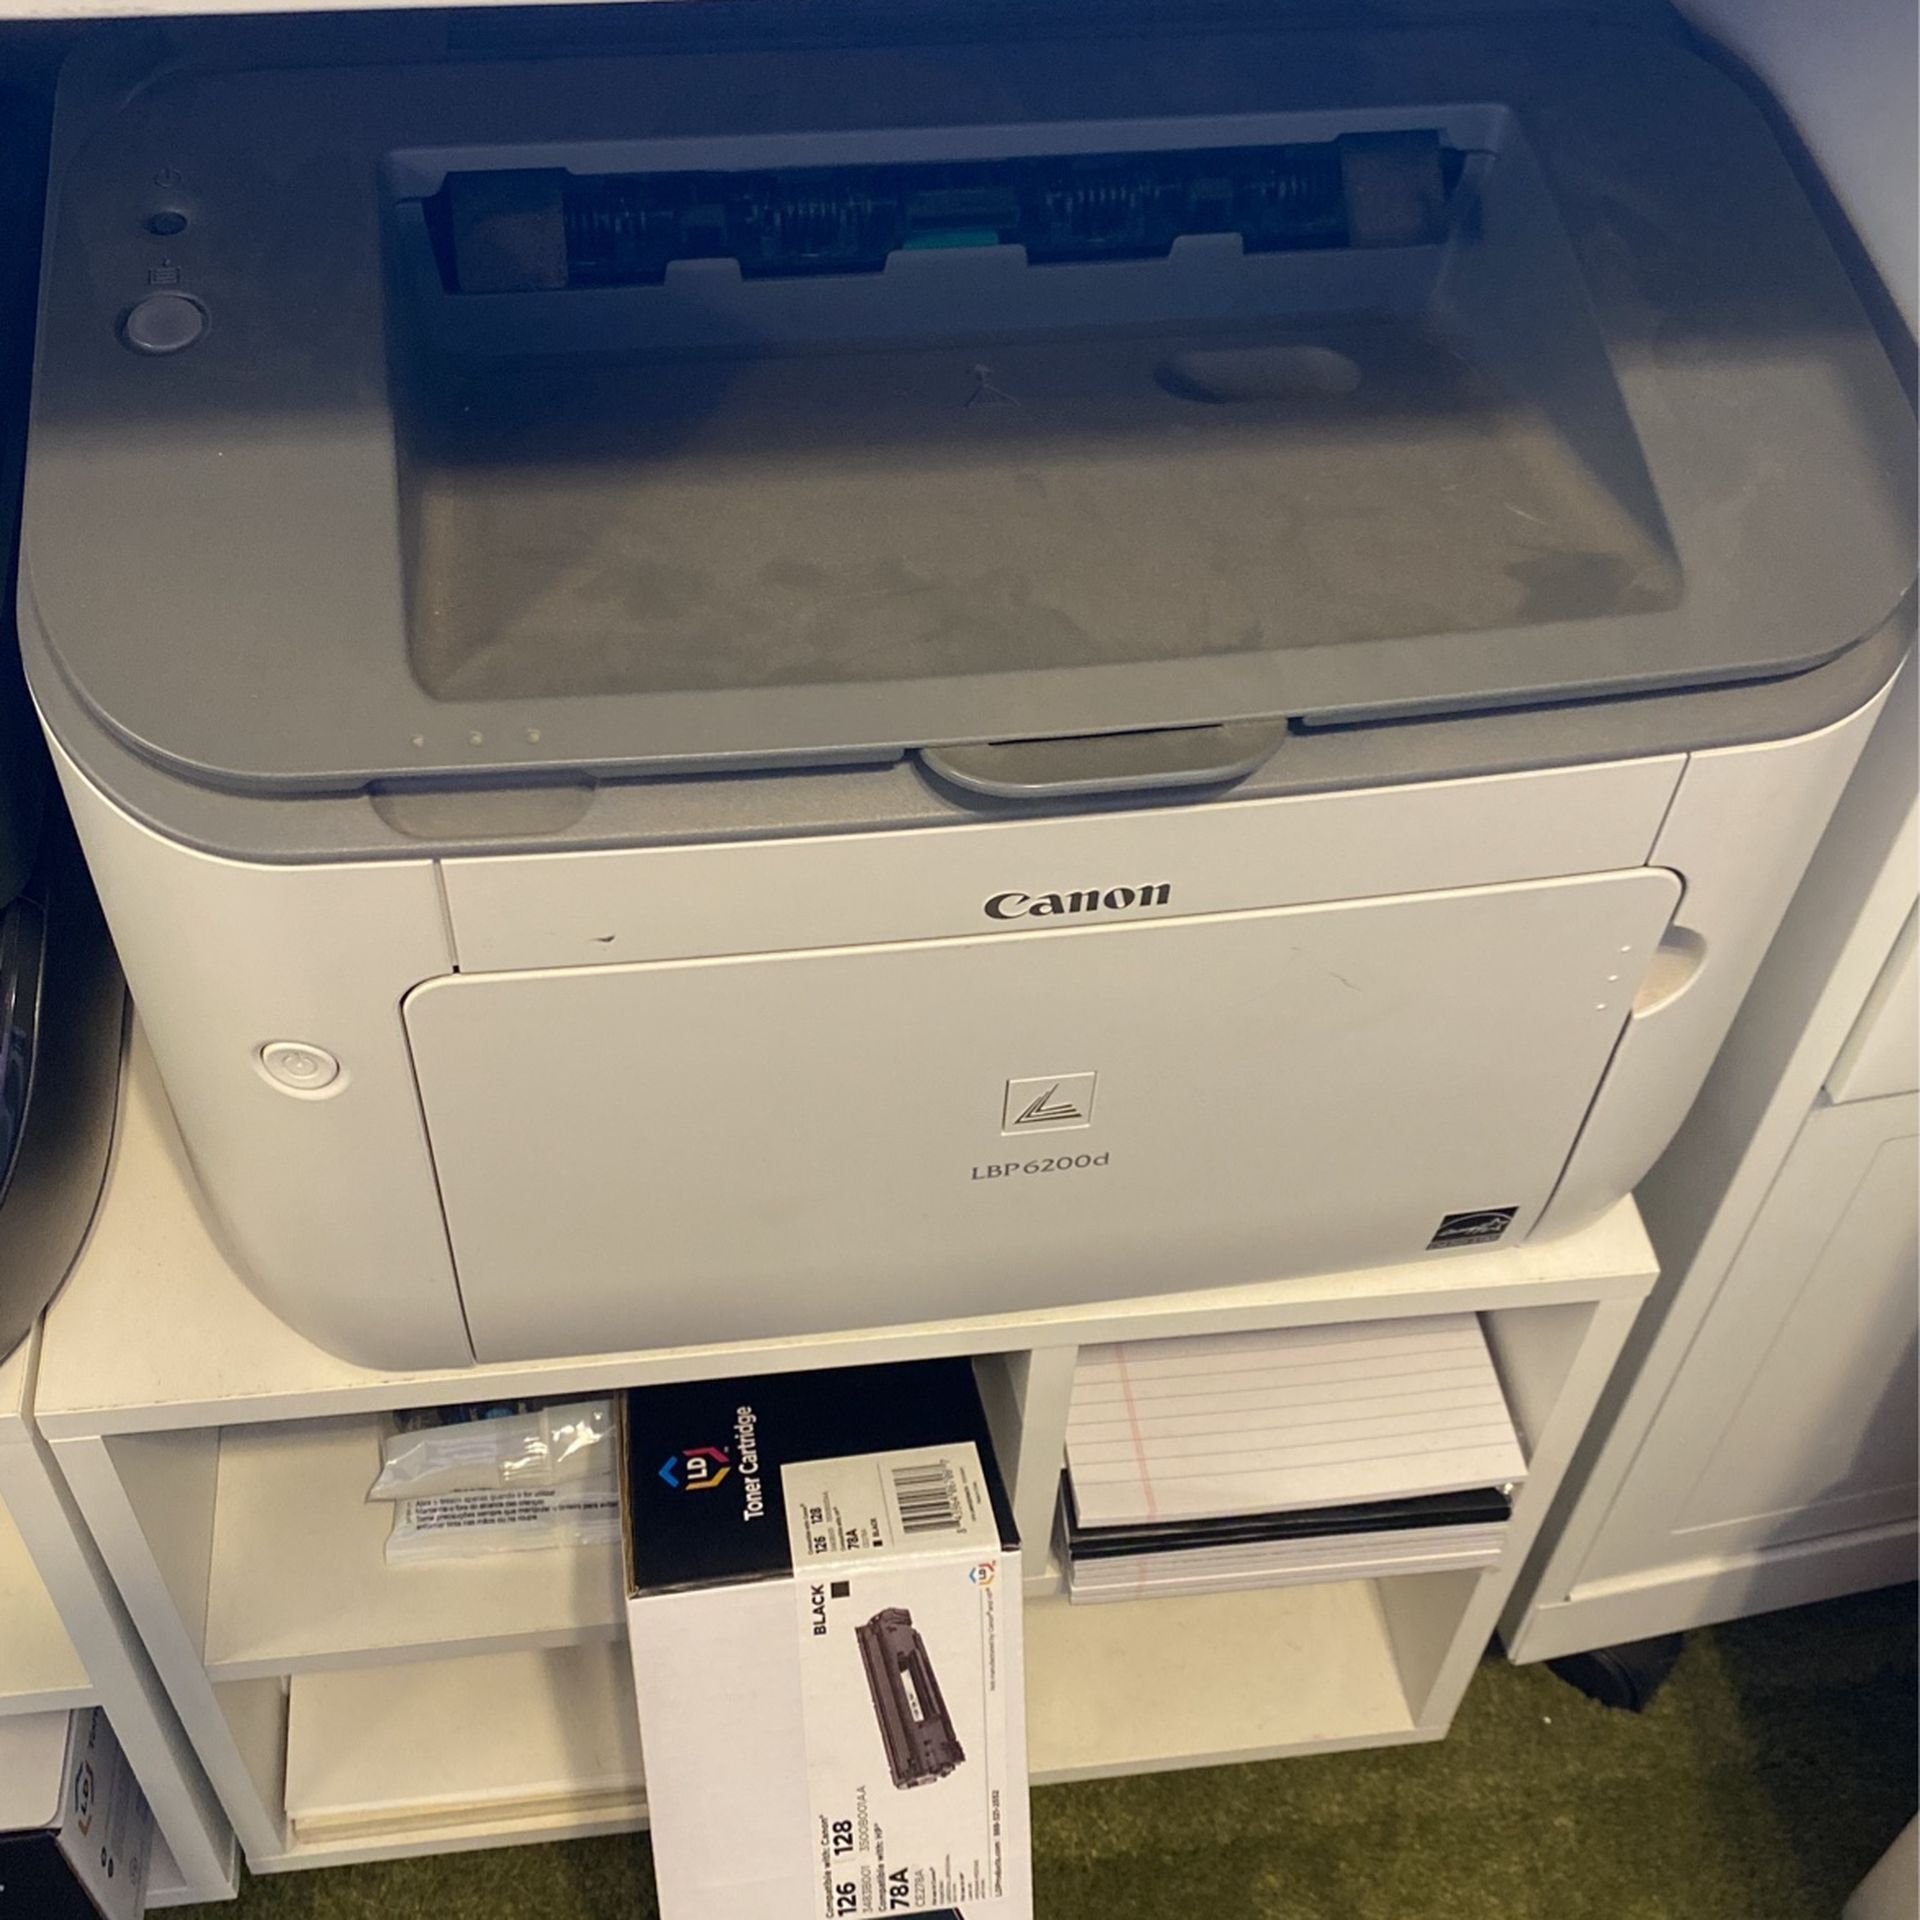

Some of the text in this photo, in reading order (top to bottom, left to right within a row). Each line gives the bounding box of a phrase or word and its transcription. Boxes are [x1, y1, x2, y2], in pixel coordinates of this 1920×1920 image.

[984, 882, 1171, 920] Canon
[972, 1152, 1110, 1180] LBP6200d
[687, 1457, 708, 1482] LD
[734, 1405, 765, 1521] Toner Cartridge
[810, 1507, 827, 1554] 126 128
[845, 1528, 860, 1550] 78A
[870, 1518, 880, 1537] BLACK
[811, 1584, 827, 1635] BLACK
[832, 1820, 857, 1917] 126 128
[889, 1867, 910, 1909] 78A
[824, 1870, 834, 1919] Compatible
